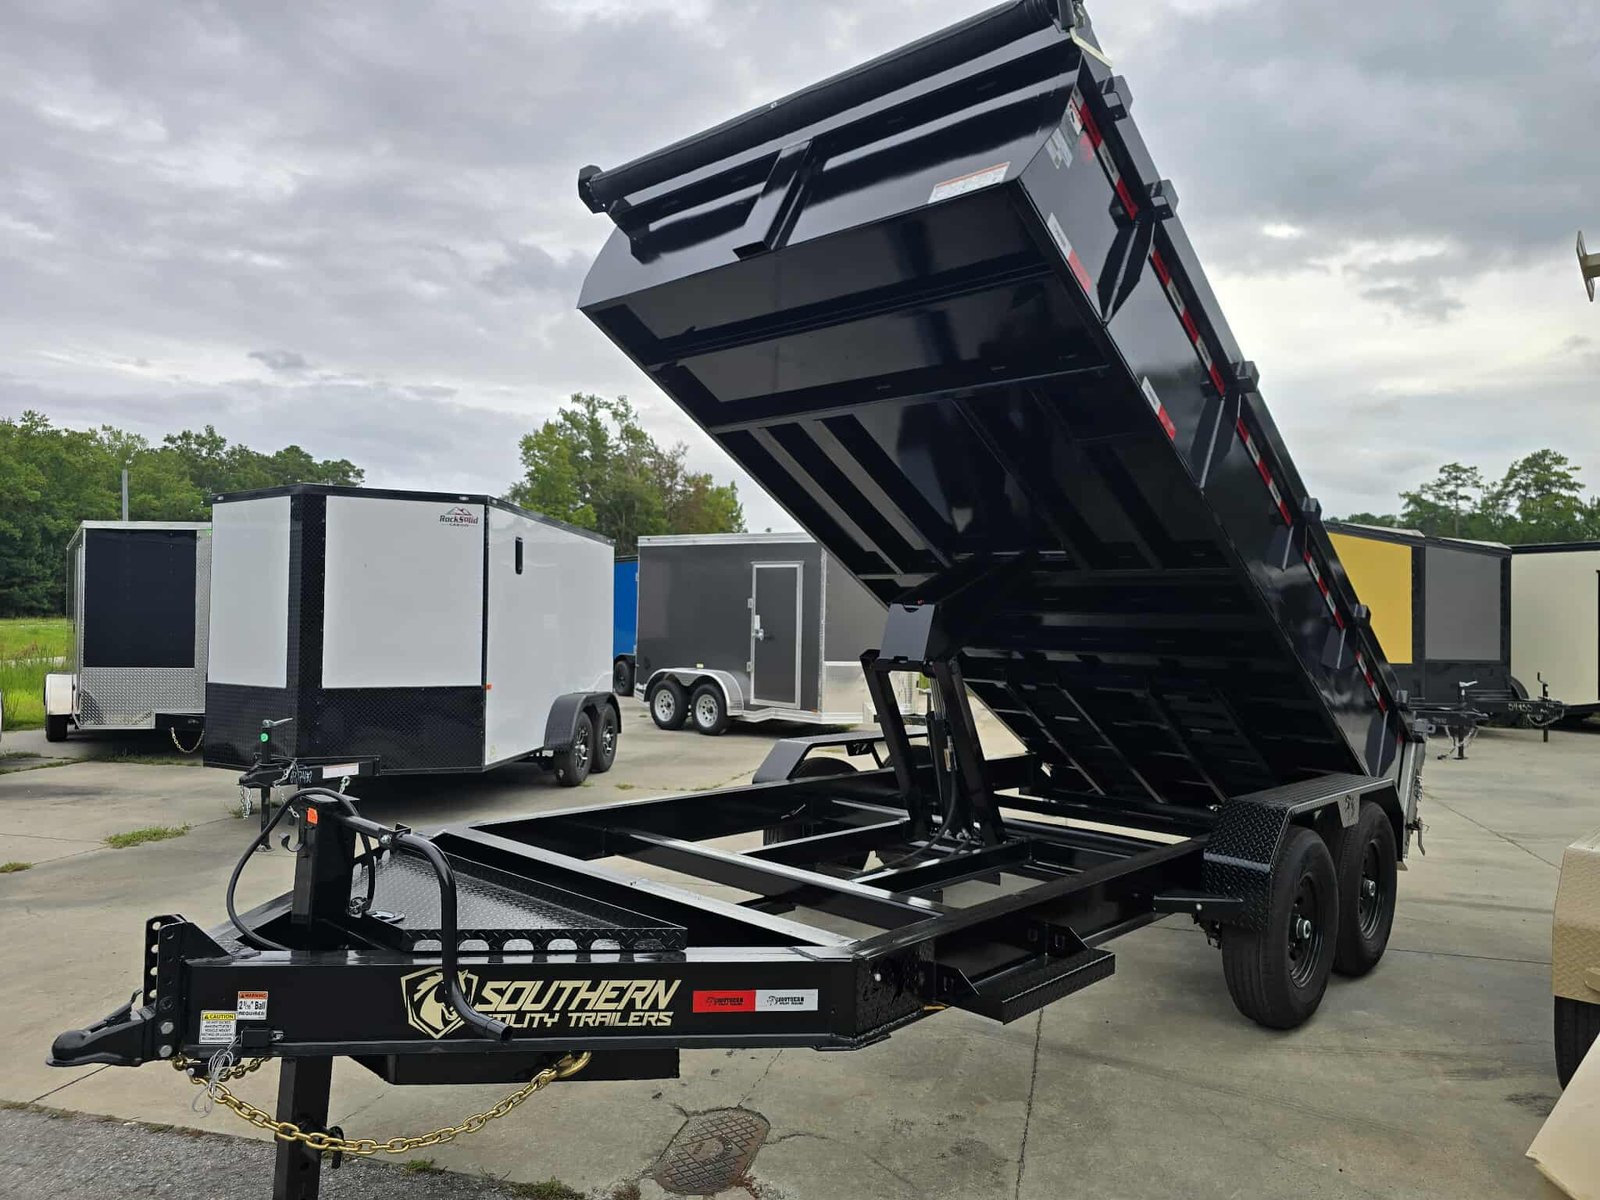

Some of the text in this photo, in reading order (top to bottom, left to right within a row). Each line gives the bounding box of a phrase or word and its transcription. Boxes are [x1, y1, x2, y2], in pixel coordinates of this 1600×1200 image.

[475, 980, 682, 1012] SOUTHERN
[488, 1011, 674, 1029] TILITY TRAILERS
